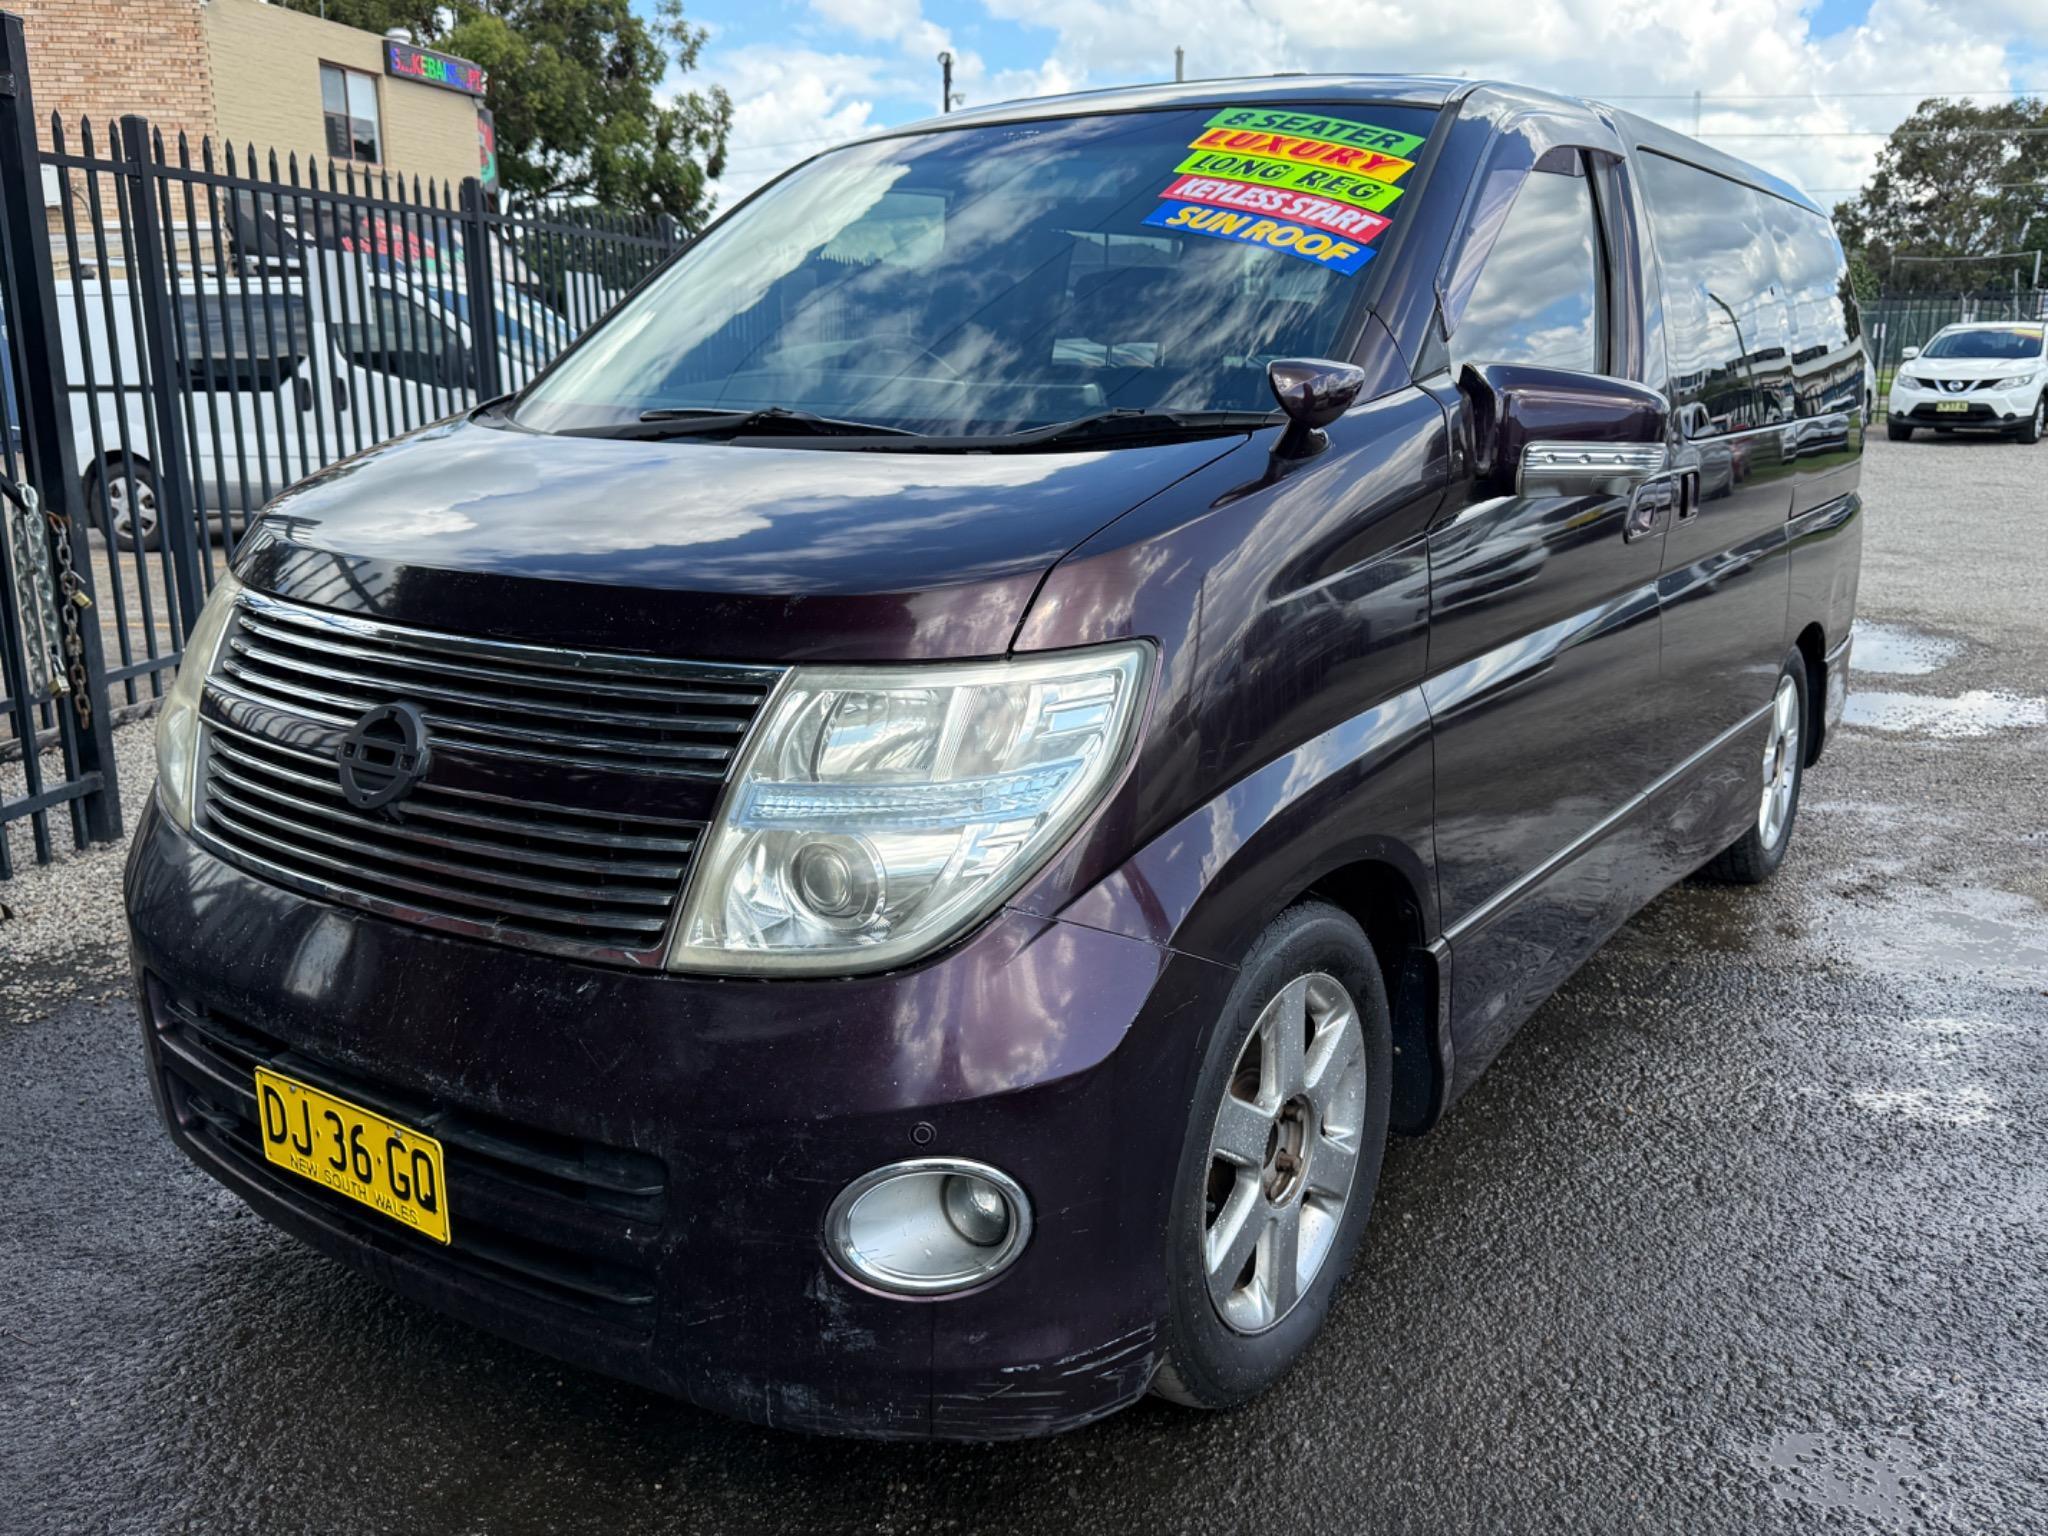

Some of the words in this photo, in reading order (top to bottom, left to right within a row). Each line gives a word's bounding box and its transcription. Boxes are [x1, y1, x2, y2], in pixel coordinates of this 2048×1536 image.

[1197, 127, 1405, 173] LUXURY
[1223, 112, 1248, 126] 8
[1251, 113, 1405, 150] SEATER
[1189, 154, 1294, 180] LONG
[1294, 170, 1385, 200] REG
[1173, 178, 1294, 211] KEYLESS
[1281, 197, 1382, 234] START
[1165, 206, 1253, 234] SUN
[1238, 220, 1360, 261] ROOF
[290, 1153, 319, 1178] NEW
[324, 1168, 368, 1201] SOUTH
[374, 1190, 420, 1225] WALES
